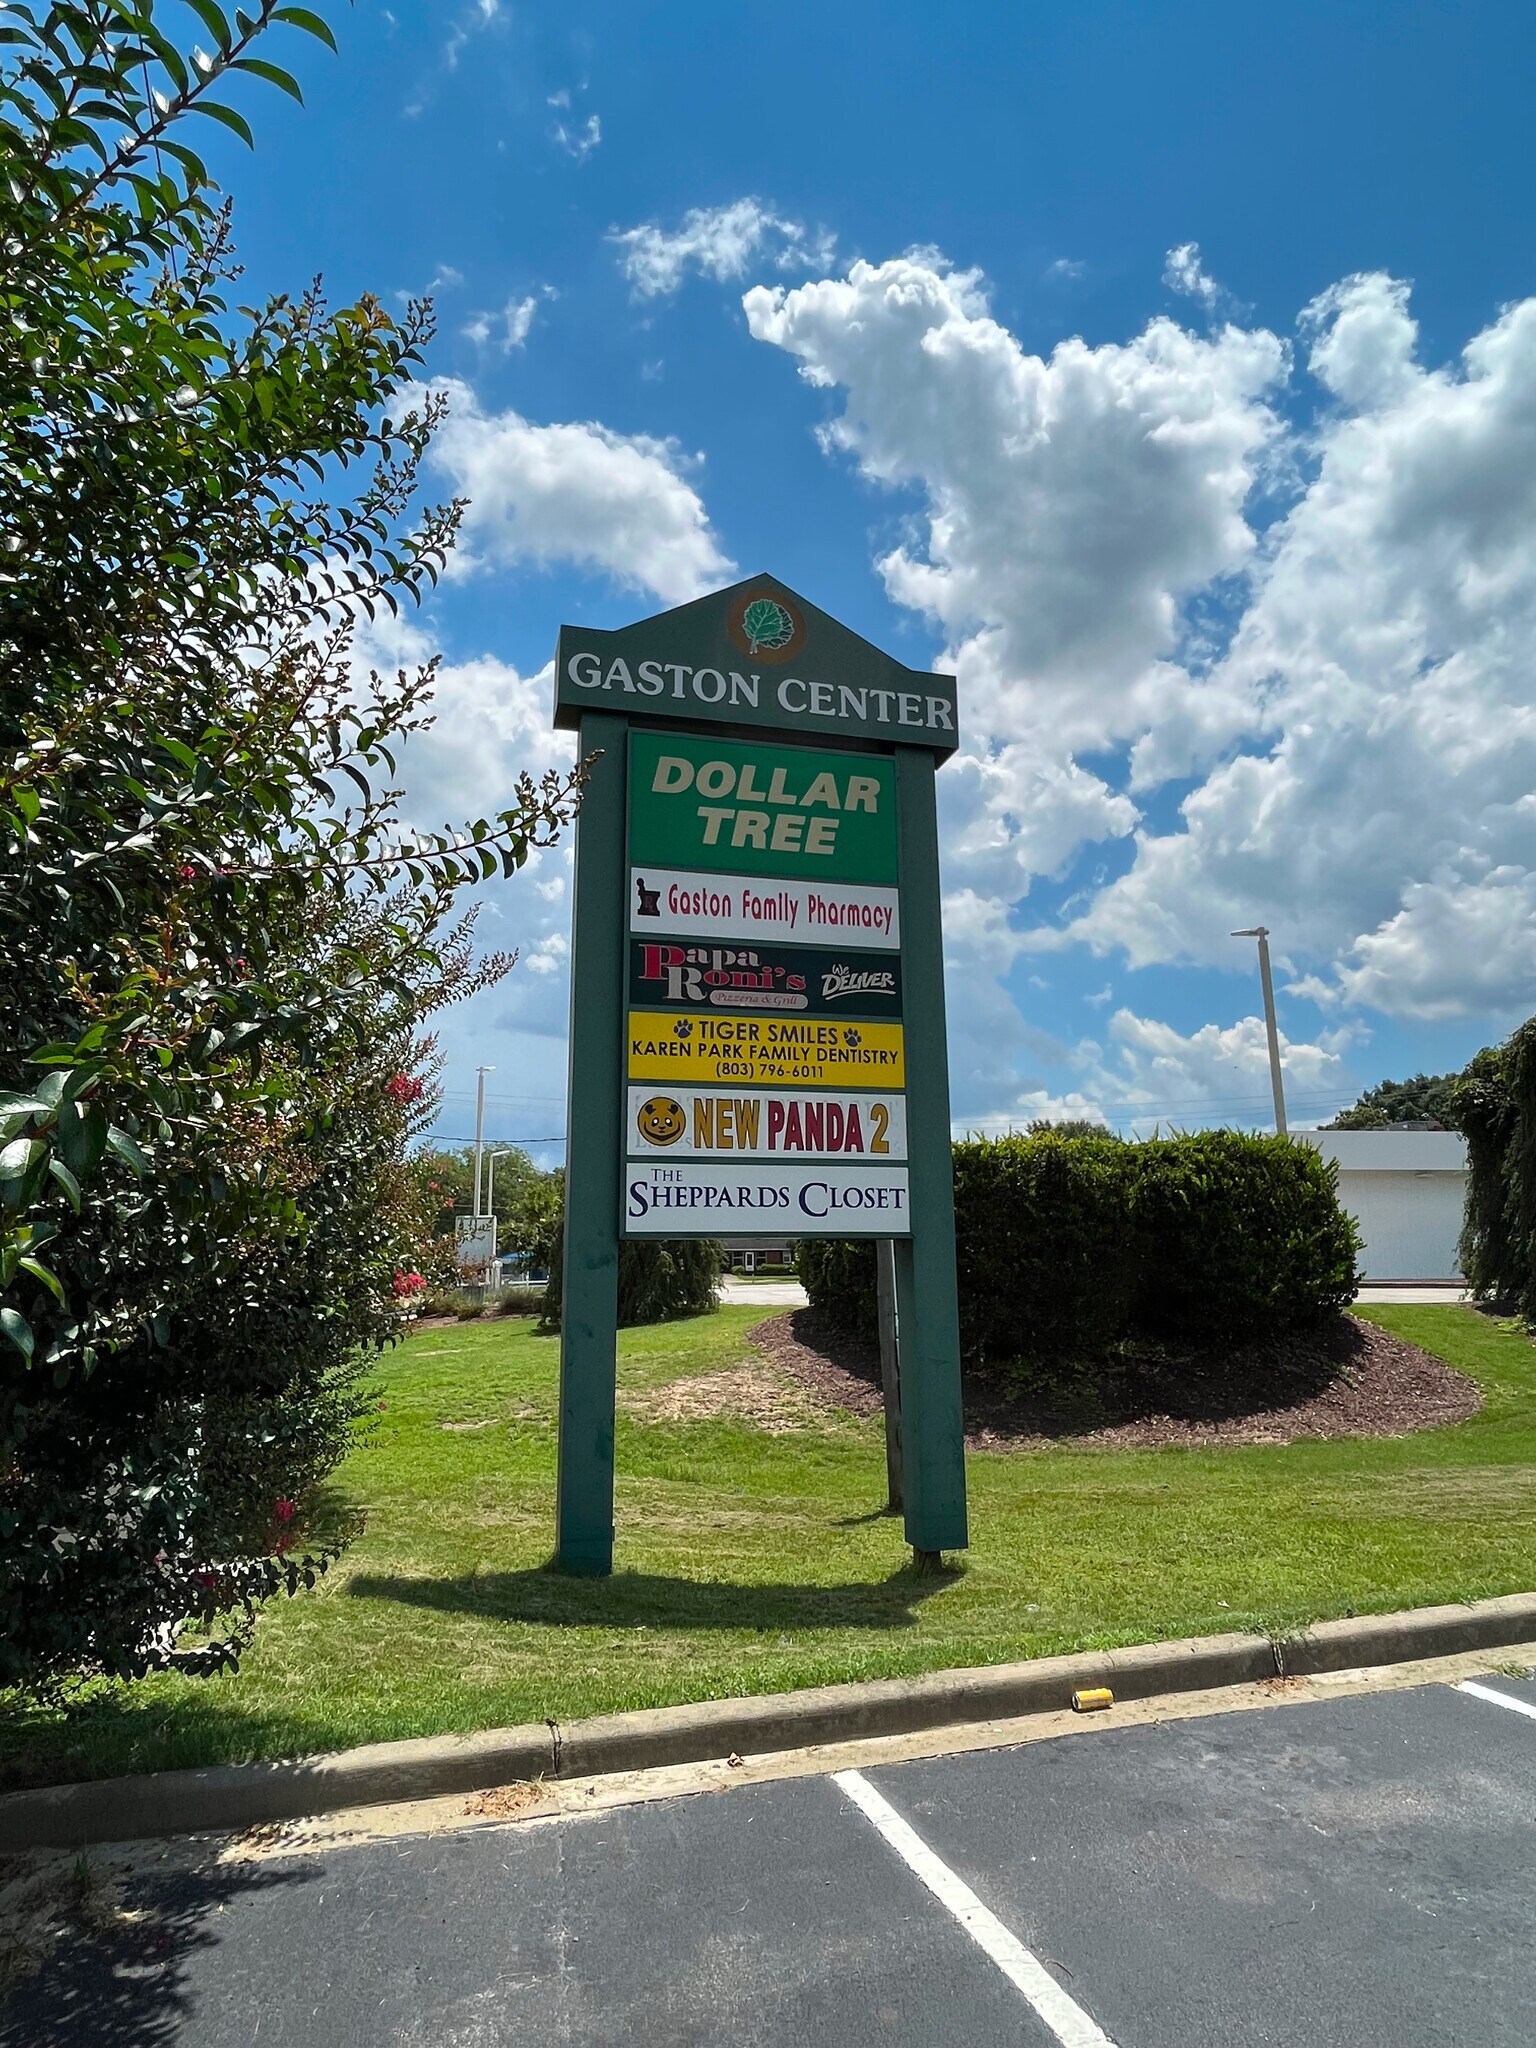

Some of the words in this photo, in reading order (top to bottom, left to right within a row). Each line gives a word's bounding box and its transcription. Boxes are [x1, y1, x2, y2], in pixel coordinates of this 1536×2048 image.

[568, 652, 760, 708] GASTON
[777, 679, 954, 731] CENTER
[651, 756, 881, 814] DOLLAR
[697, 807, 840, 856] TREE
[668, 883, 732, 918] Gaston
[808, 894, 893, 935] Pharmacy
[638, 943, 761, 981] Papa
[832, 963, 850, 976] We
[664, 966, 807, 1000] Roni's
[715, 992, 758, 1003] Pizzeria
[774, 996, 797, 1006] Grill
[821, 971, 896, 997] DELIVER
[699, 1021, 759, 1042] TIGER
[768, 1024, 838, 1045] SMILES
[632, 1040, 691, 1057] KAREN
[698, 1043, 743, 1060] PARK
[749, 1045, 810, 1062] FAMILY
[816, 1048, 899, 1065] DENTISTRY
[716, 1061, 754, 1080] (803)
[759, 1063, 824, 1079] 796-6011
[693, 1097, 760, 1150] NEW
[767, 1100, 865, 1153] PANDA
[869, 1103, 890, 1154] 2
[651, 1168, 683, 1182] THE
[628, 1180, 790, 1218] SHEPPARDS
[798, 1182, 906, 1217] CLOSET
